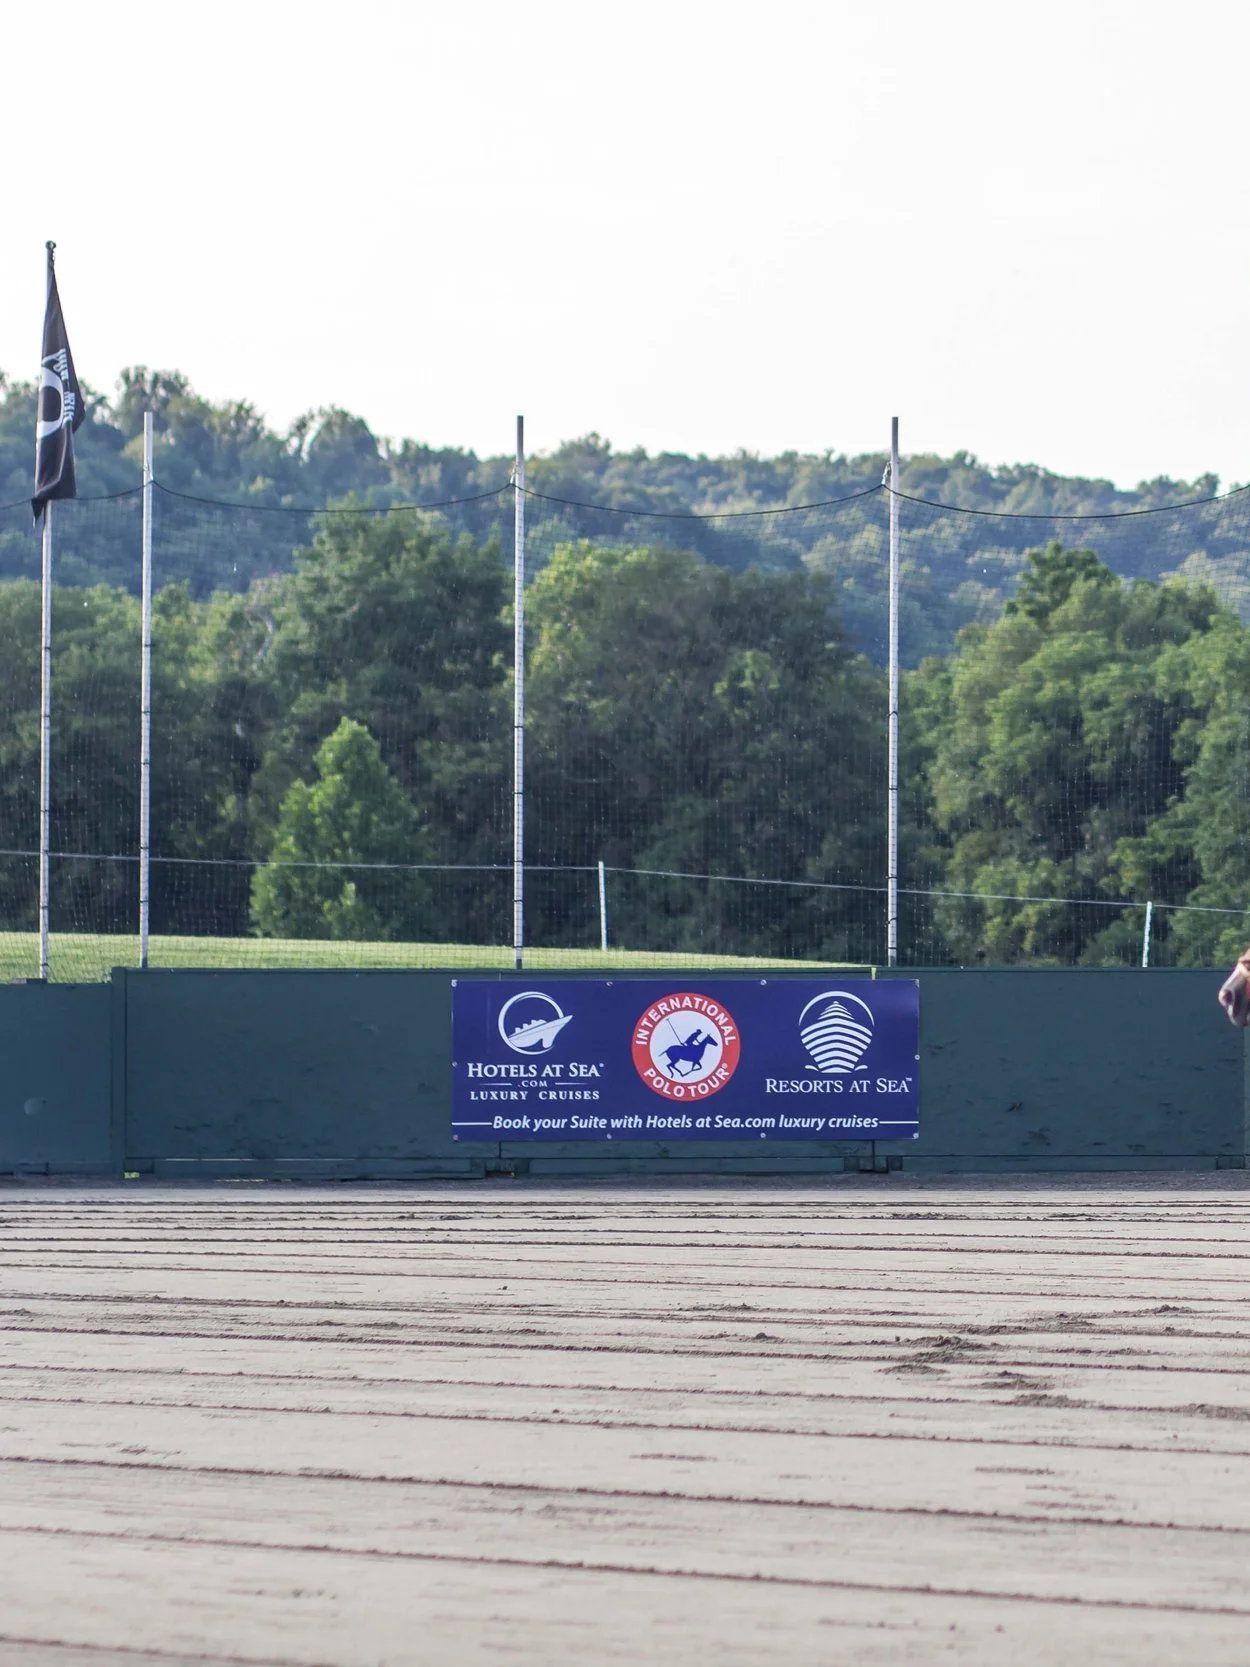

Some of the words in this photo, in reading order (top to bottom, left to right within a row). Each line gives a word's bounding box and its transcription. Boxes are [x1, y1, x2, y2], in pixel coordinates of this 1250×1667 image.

[635, 996, 737, 1046] INTERNATIONAL
[541, 1063, 564, 1078] AT
[517, 1080, 548, 1088] .COM
[643, 1067, 686, 1098] POLO
[687, 1066, 731, 1098] TOUR
[848, 1079, 871, 1093] AT
[470, 1090, 529, 1101] LUXURY
[538, 1090, 601, 1101] CRUISES
[493, 1115, 531, 1129] Book
[533, 1117, 567, 1132] your
[570, 1115, 607, 1129] Suite
[610, 1115, 643, 1128] with
[646, 1115, 693, 1128] Hotels
[695, 1116, 712, 1128] at
[714, 1115, 776, 1128] Sea.com
[779, 1114, 826, 1131] luxury
[828, 1115, 879, 1128] cruises
